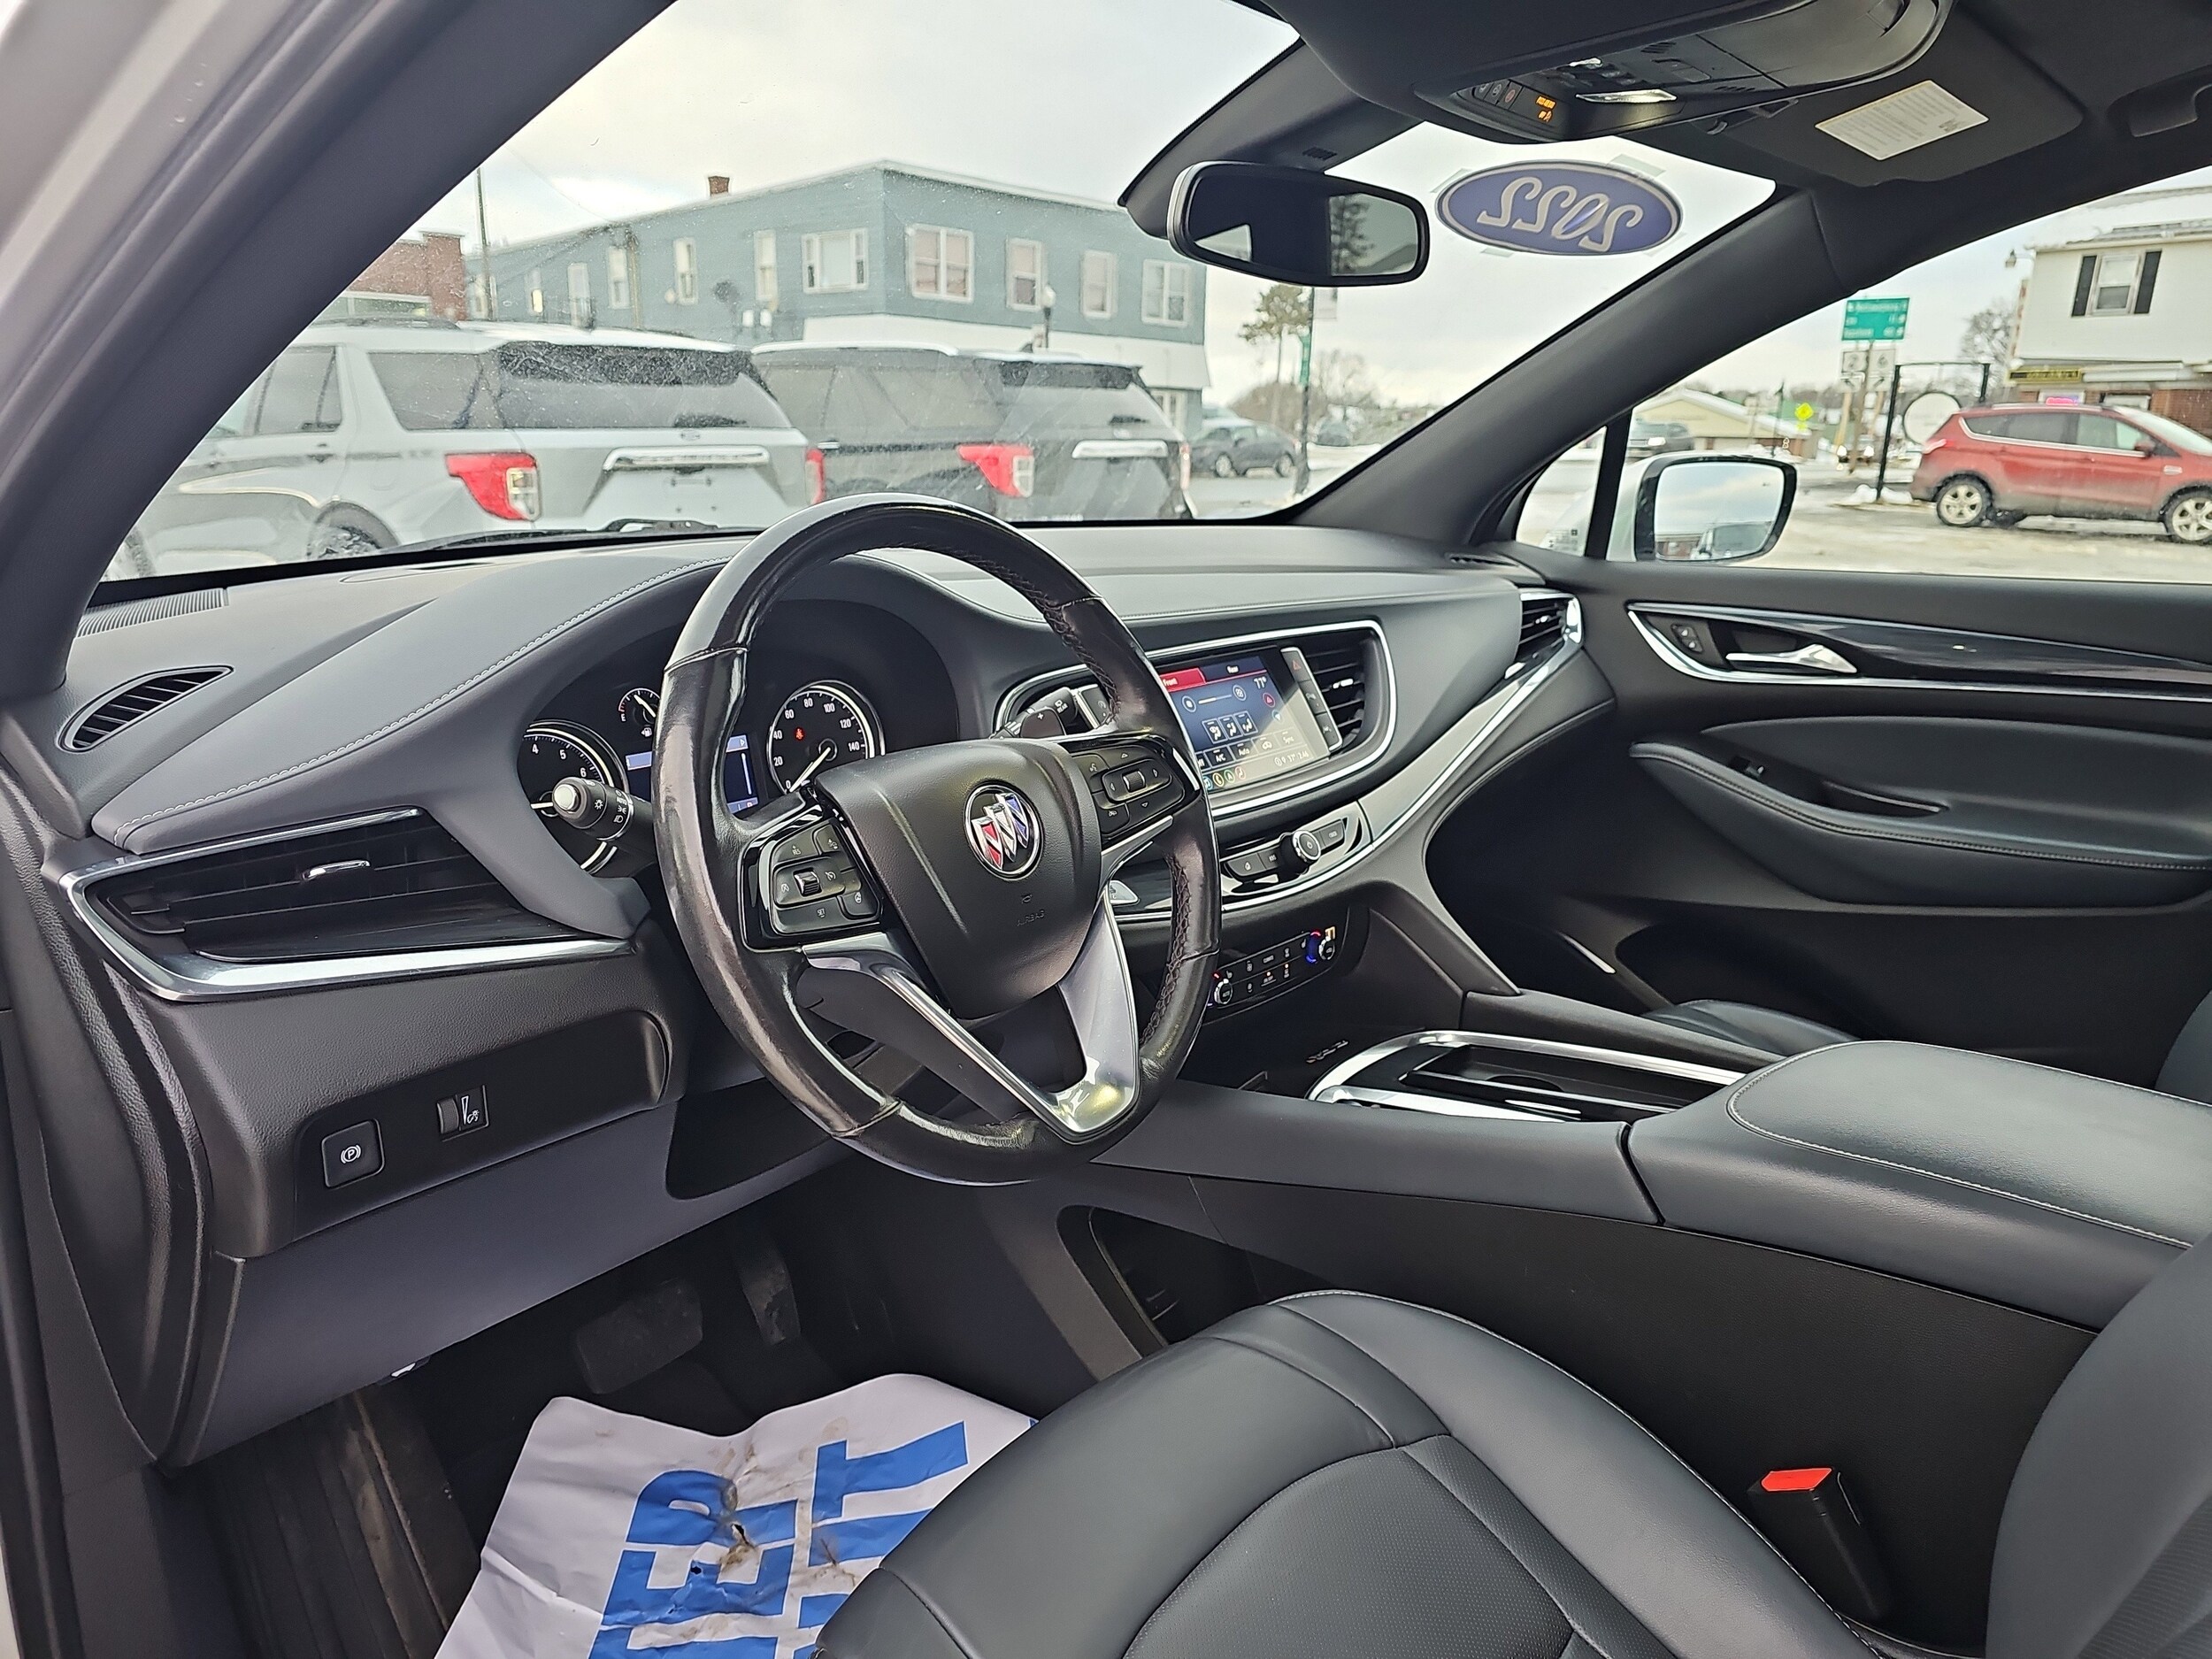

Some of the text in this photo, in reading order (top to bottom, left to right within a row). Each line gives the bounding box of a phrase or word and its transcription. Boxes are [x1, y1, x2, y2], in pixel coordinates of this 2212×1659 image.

[803, 697, 813, 708] 80
[823, 703, 835, 713] 100
[620, 712, 626, 722] E
[784, 709, 795, 719] 60
[840, 718, 851, 729] 120
[772, 729, 783, 740] 40
[532, 743, 539, 755] 4
[848, 741, 860, 752] 140
[559, 749, 566, 760] 5
[773, 756, 783, 767] 20
[580, 767, 587, 778] 6
[785, 780, 791, 789] 0
[817, 908, 826, 917] SET
